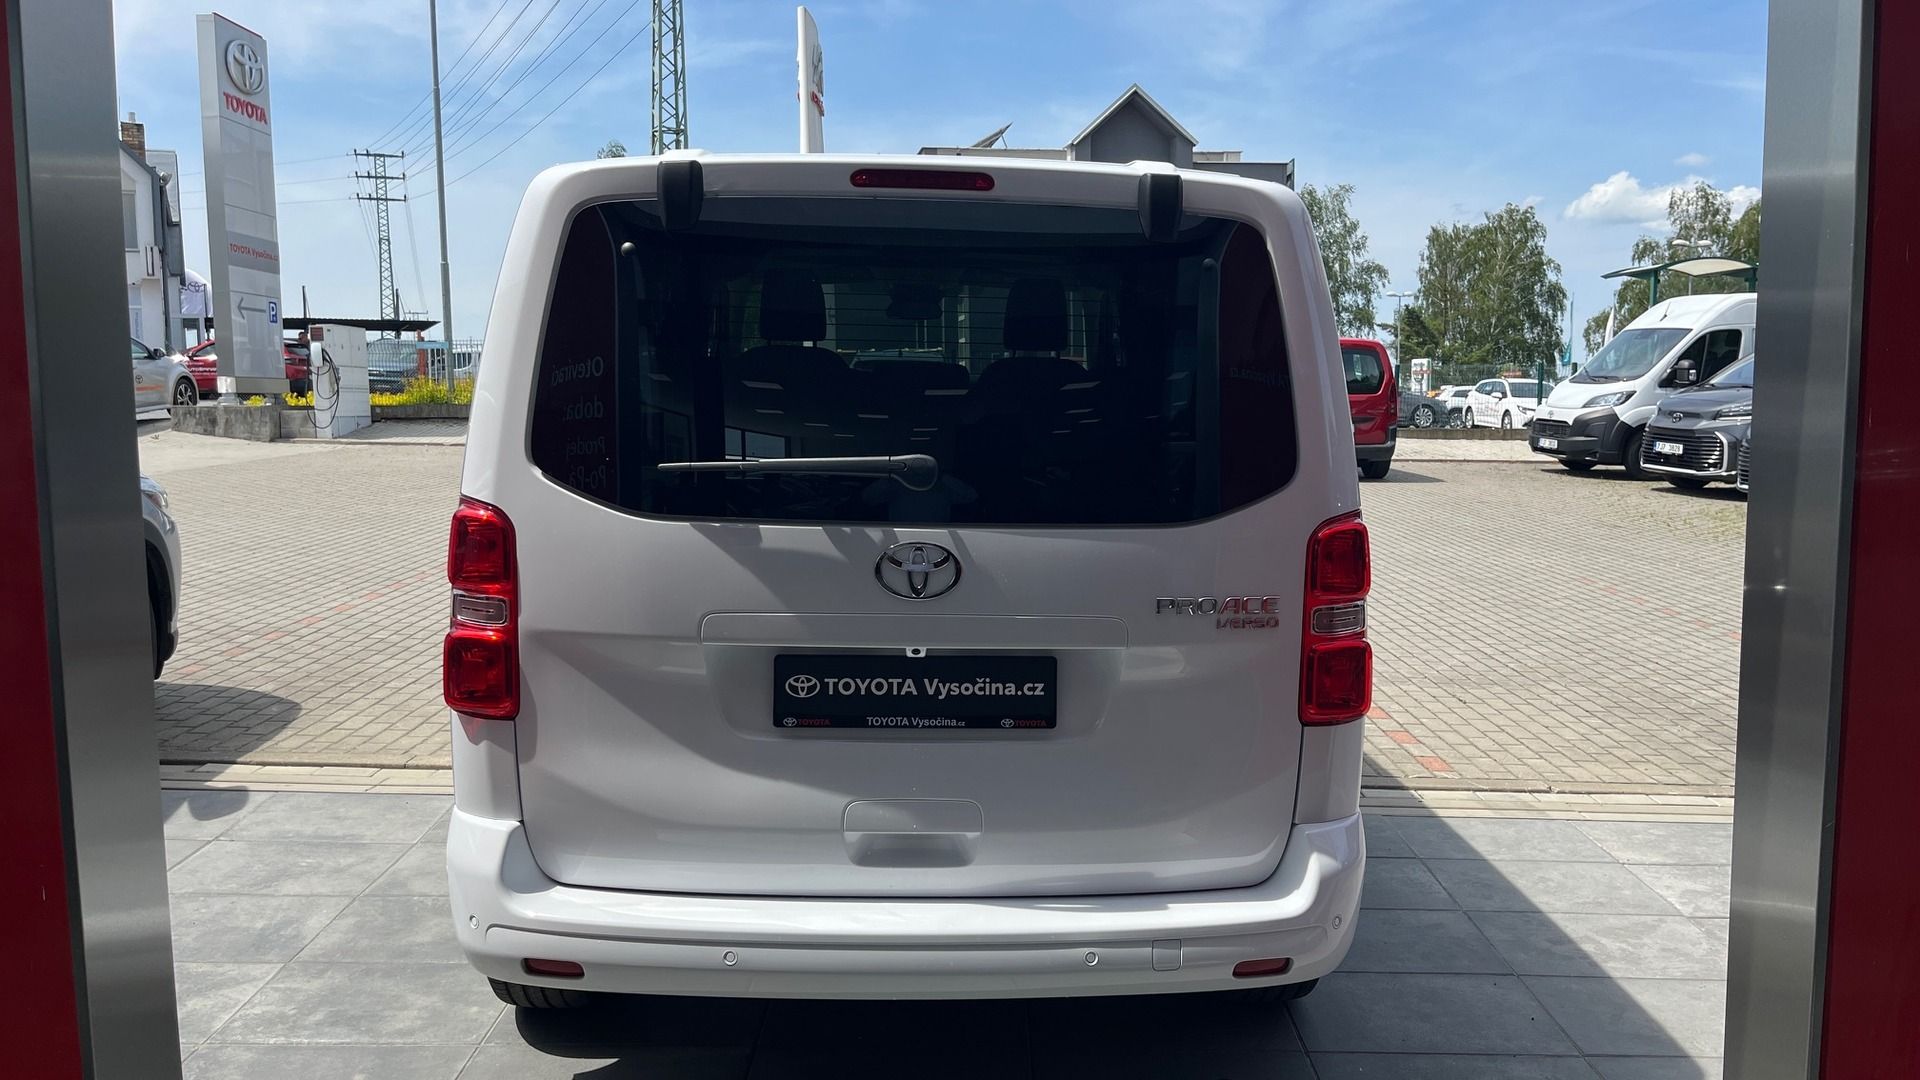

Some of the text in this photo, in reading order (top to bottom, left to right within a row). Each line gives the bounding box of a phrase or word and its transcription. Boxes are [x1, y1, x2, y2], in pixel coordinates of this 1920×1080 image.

[223, 91, 268, 125] TOYOTA
[229, 243, 252, 257] TOYOTA
[1156, 596, 1280, 615] PROACE
[1216, 617, 1279, 629] VERSO
[824, 677, 1045, 700] TOYOTA Vysočina.cz
[866, 717, 966, 728] TOYOTA Vysočina.cz
[1015, 719, 1047, 727] TOYOTA
